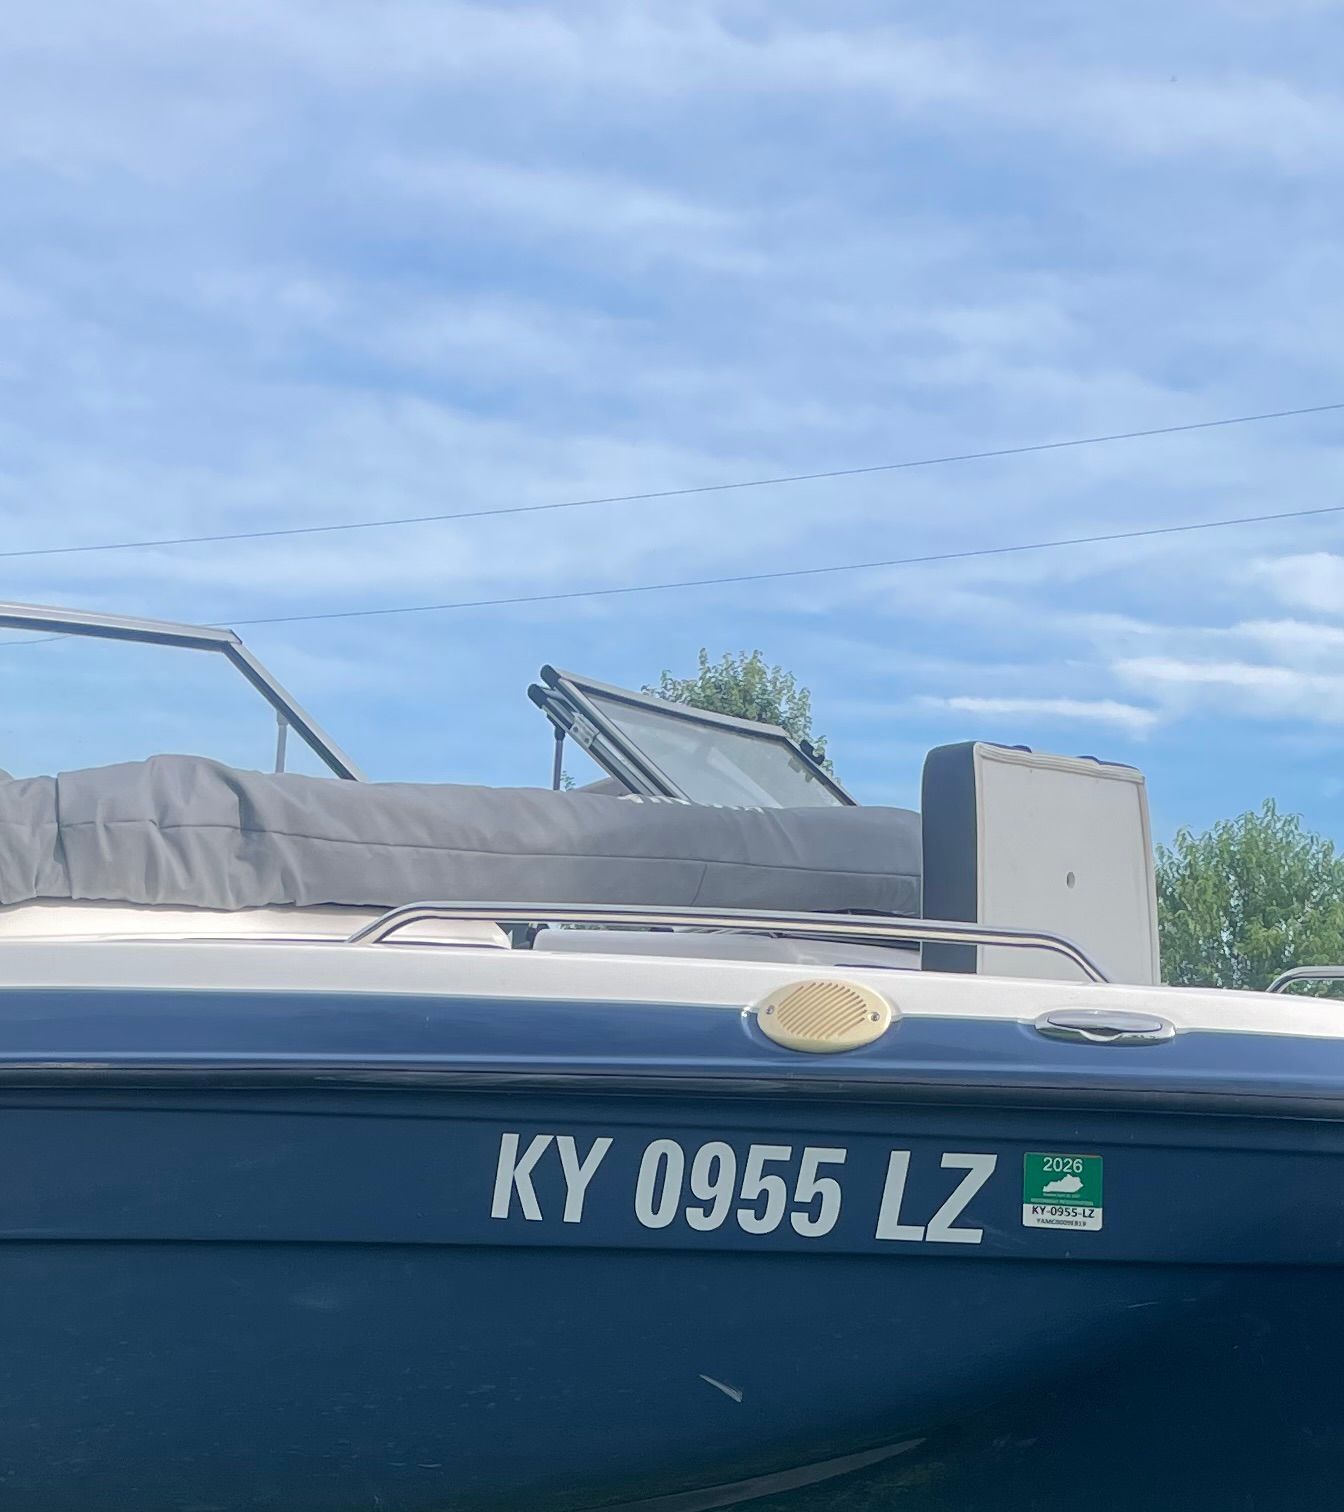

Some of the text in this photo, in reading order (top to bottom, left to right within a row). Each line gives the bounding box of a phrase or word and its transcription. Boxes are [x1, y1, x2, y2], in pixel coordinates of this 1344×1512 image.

[1042, 1156, 1084, 1173] 2026
[490, 1132, 999, 1245] KY 0955 LZ
[1031, 1205, 1095, 1219] KY-0955-LZ
